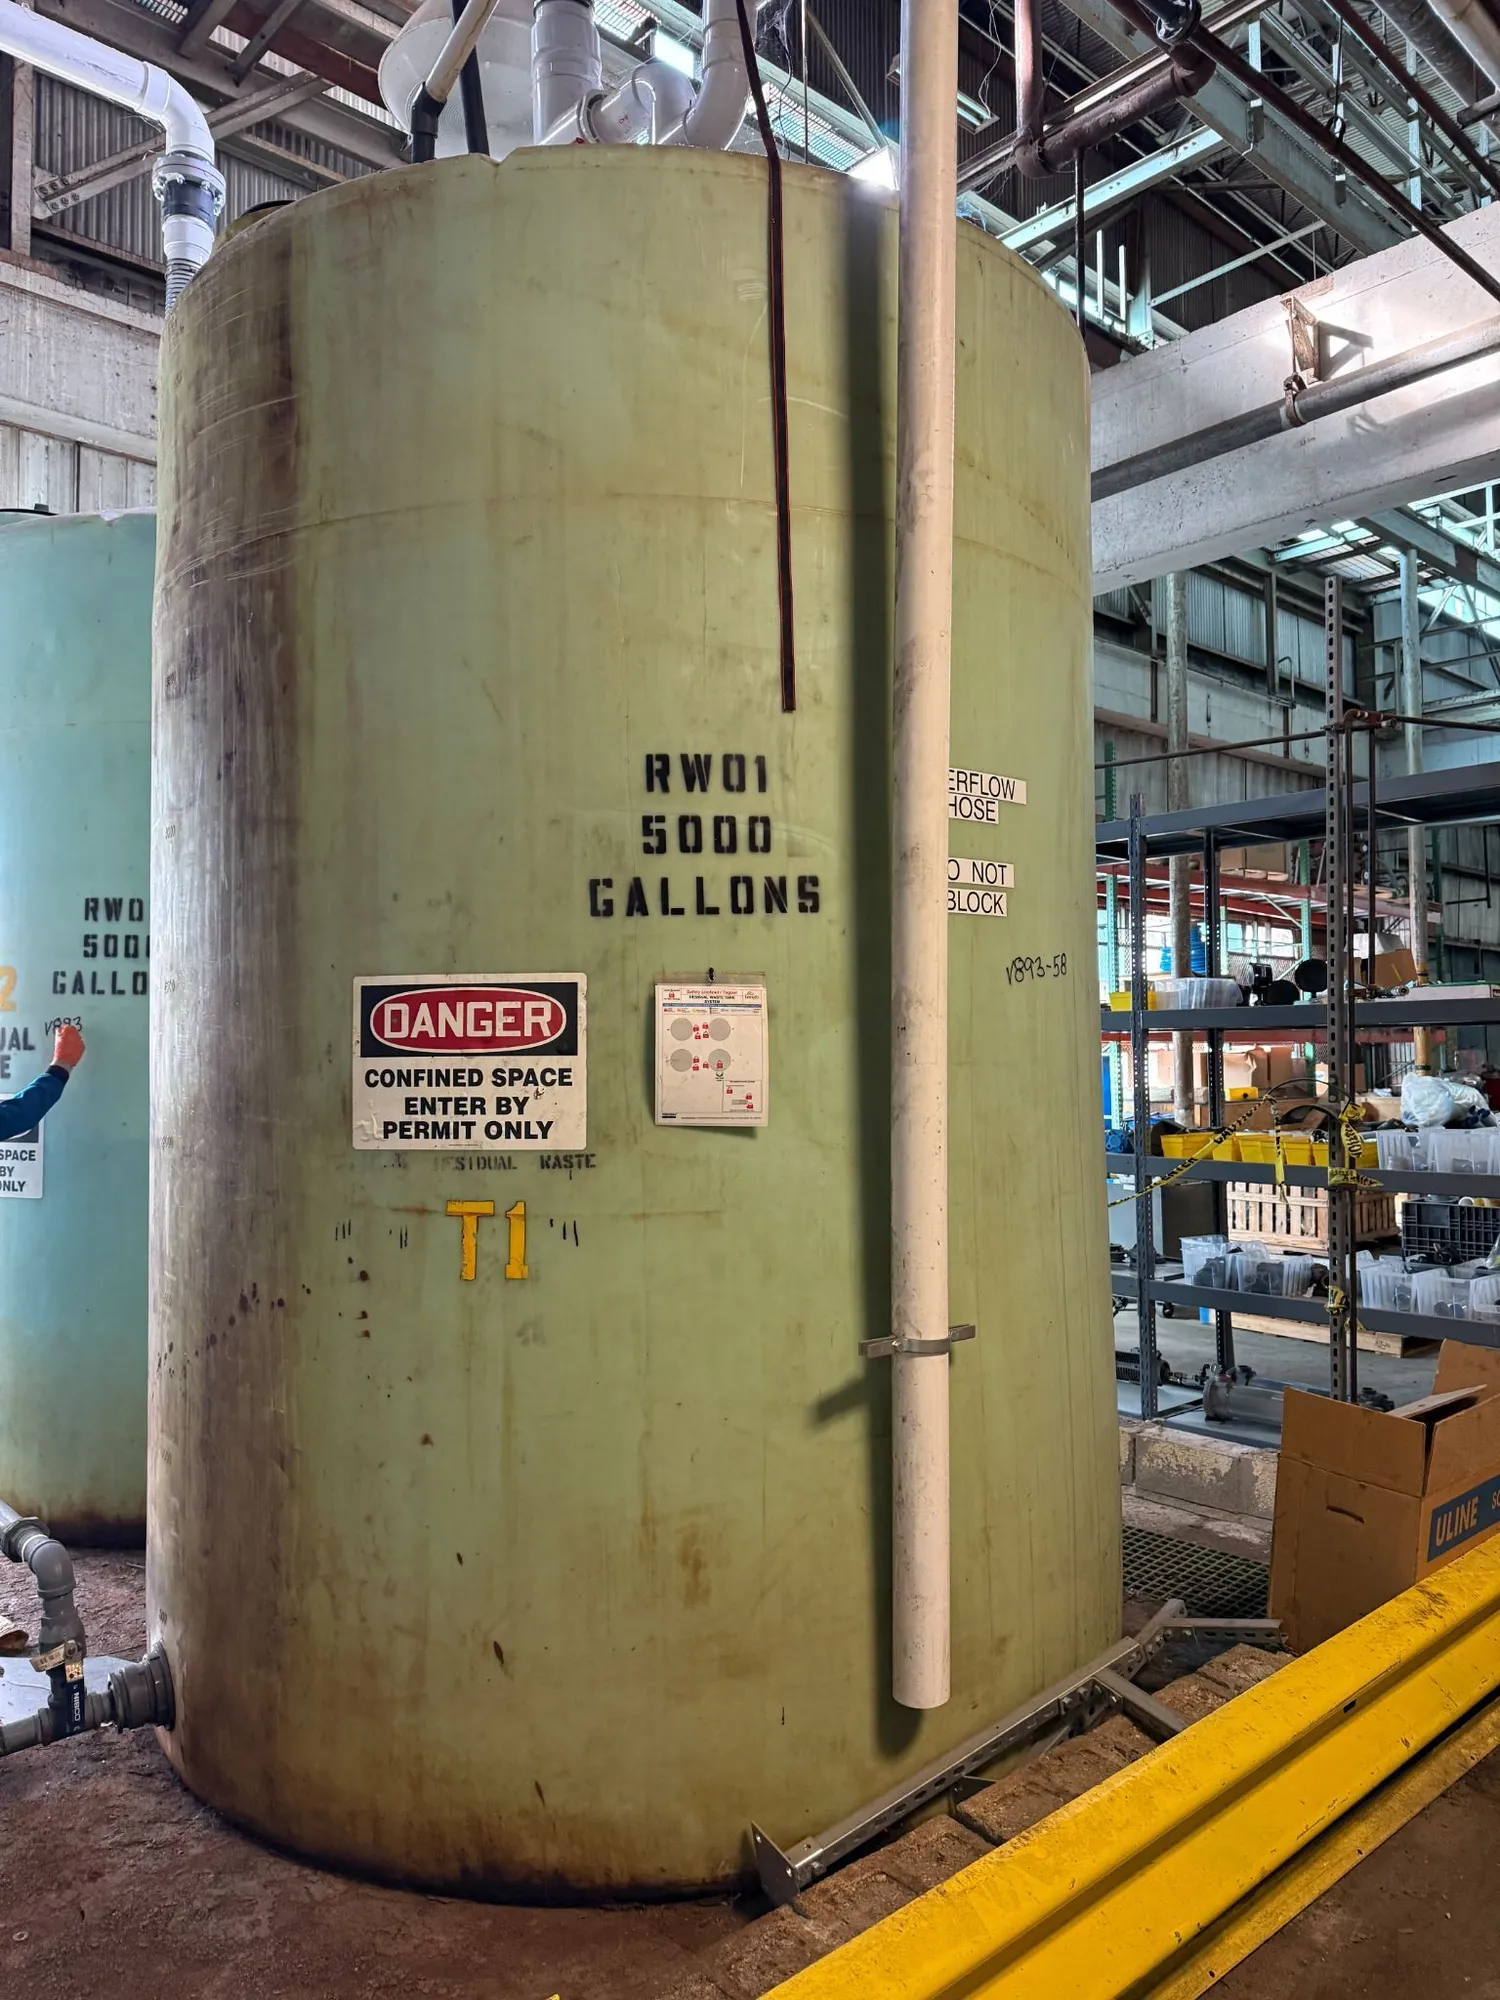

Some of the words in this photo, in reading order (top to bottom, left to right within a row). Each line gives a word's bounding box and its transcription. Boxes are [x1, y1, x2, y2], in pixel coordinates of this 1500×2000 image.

[645, 753, 767, 793] RW01
[642, 815, 771, 854] 5000
[972, 861, 1008, 885] NOT
[589, 875, 820, 917] GALLONS
[947, 889, 1004, 915] BLOCK
[83, 934, 150, 959] 500
[53, 970, 148, 995] GALLO
[1006, 953, 1067, 985] V893-58
[384, 1001, 552, 1039] DANGER
[365, 1068, 484, 1087] CONFINED
[491, 1067, 573, 1087] SPACE
[404, 1096, 486, 1116] ENTER
[495, 1096, 530, 1115] BY
[383, 1120, 476, 1140] PERMIT
[484, 1120, 554, 1140] ONLY
[0, 1180, 26, 1192] NLY
[445, 1200, 529, 1281] T1
[1436, 1495, 1479, 1547] ULINE
[73, 1692, 81, 1722] NIBCO
